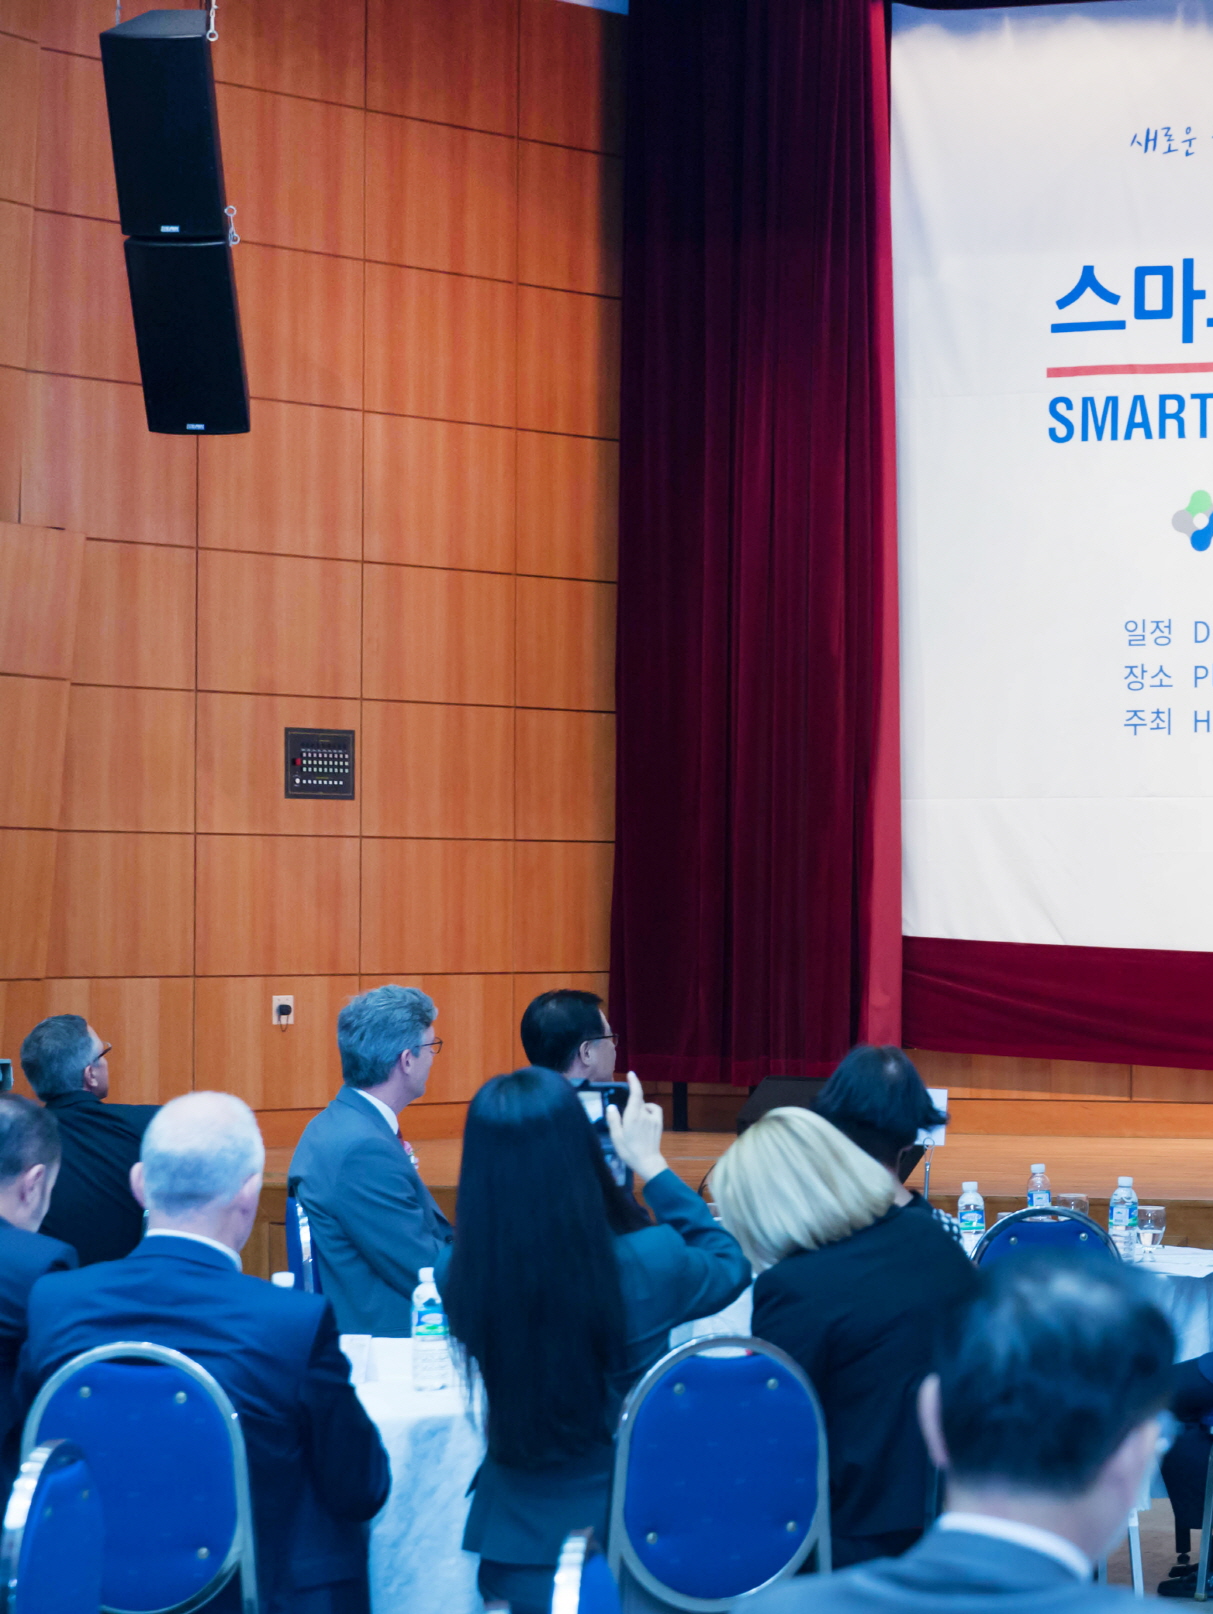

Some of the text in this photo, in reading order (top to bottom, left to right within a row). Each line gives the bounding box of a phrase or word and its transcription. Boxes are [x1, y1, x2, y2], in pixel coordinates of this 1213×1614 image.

[1131, 127, 1196, 157] 새로운
[1124, 619, 1171, 646] 일정
[1124, 664, 1173, 691] 장소
[1124, 708, 1171, 736] 주최
